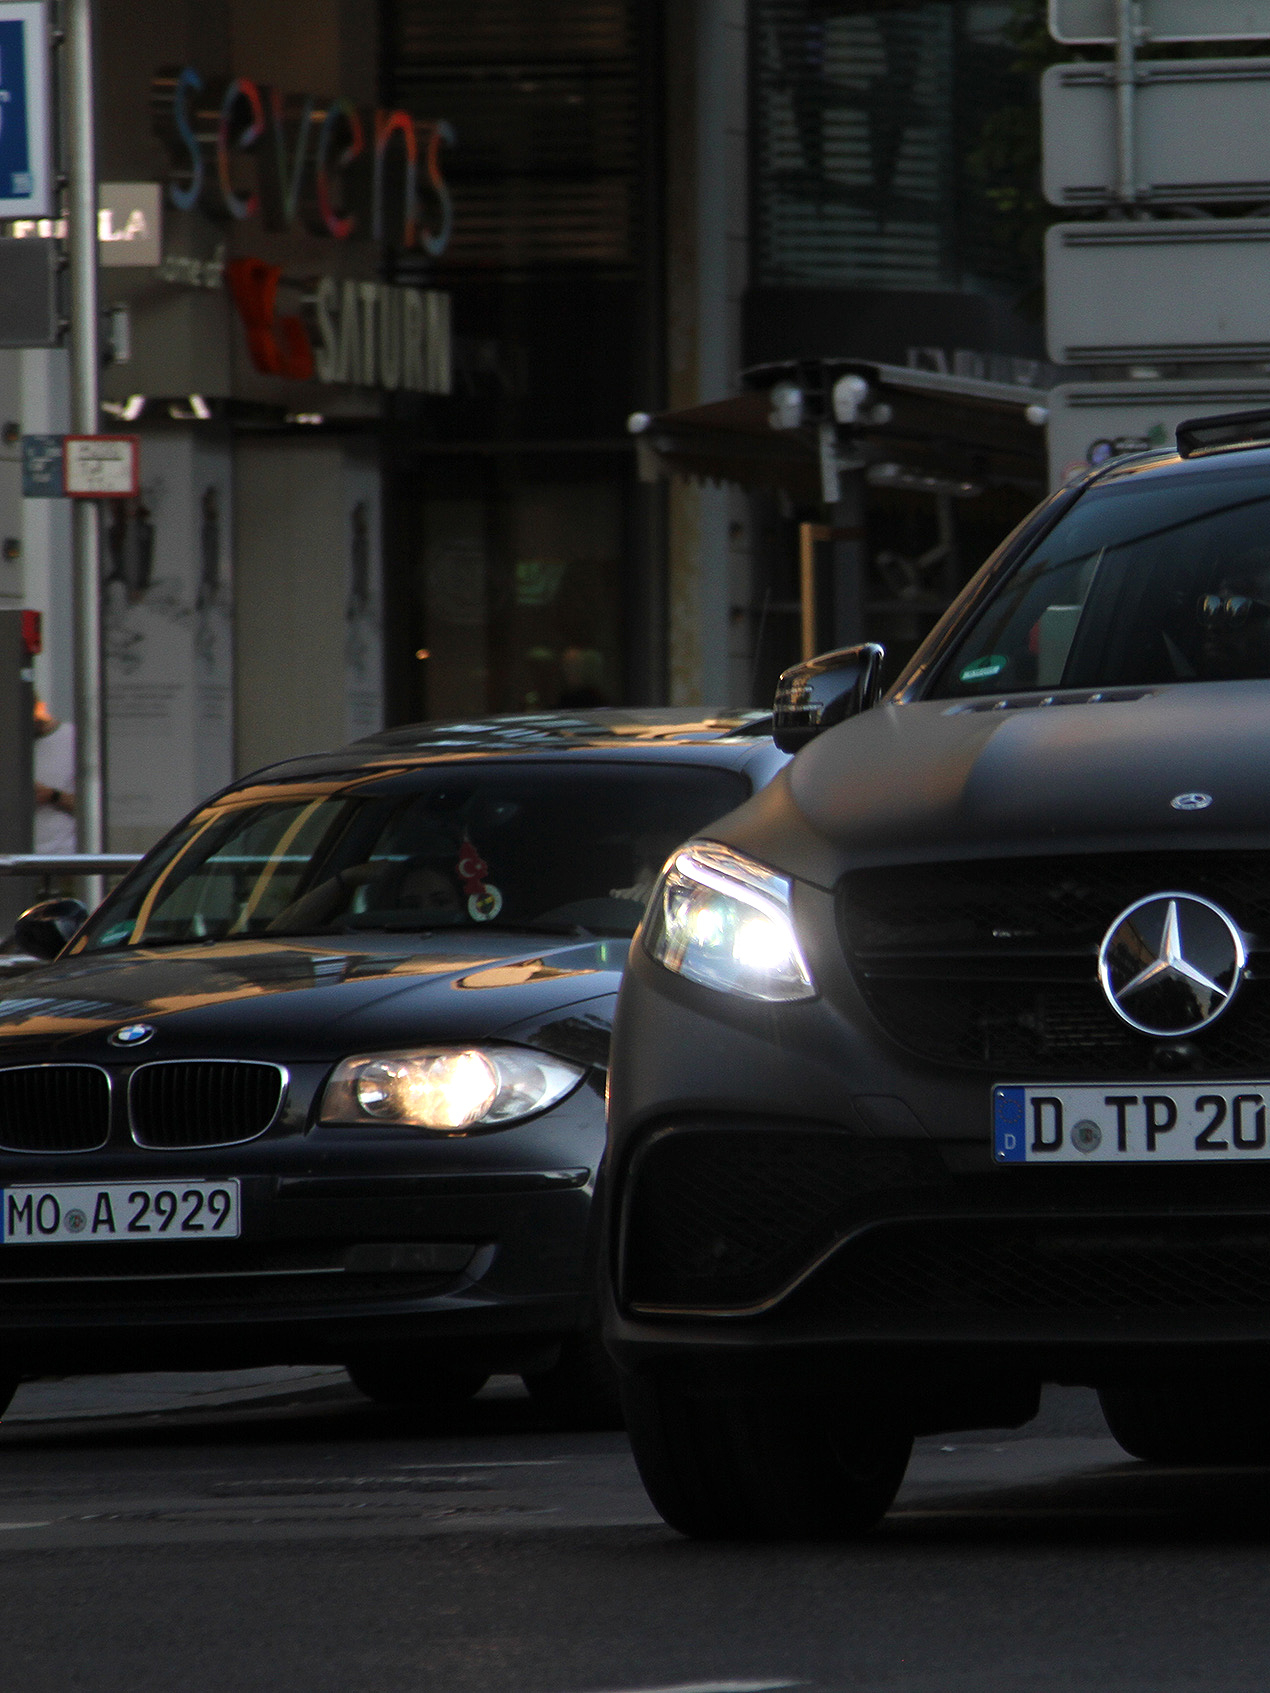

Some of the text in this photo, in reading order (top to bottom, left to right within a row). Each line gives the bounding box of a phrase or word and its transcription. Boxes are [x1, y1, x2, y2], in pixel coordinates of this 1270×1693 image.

[170, 66, 457, 257] sevens
[12, 209, 147, 241] FULA
[316, 274, 453, 396] SATURN
[1031, 1096, 1063, 1151] D
[1104, 1095, 1178, 1152] TP
[8, 1189, 231, 1235] MO A 2929
